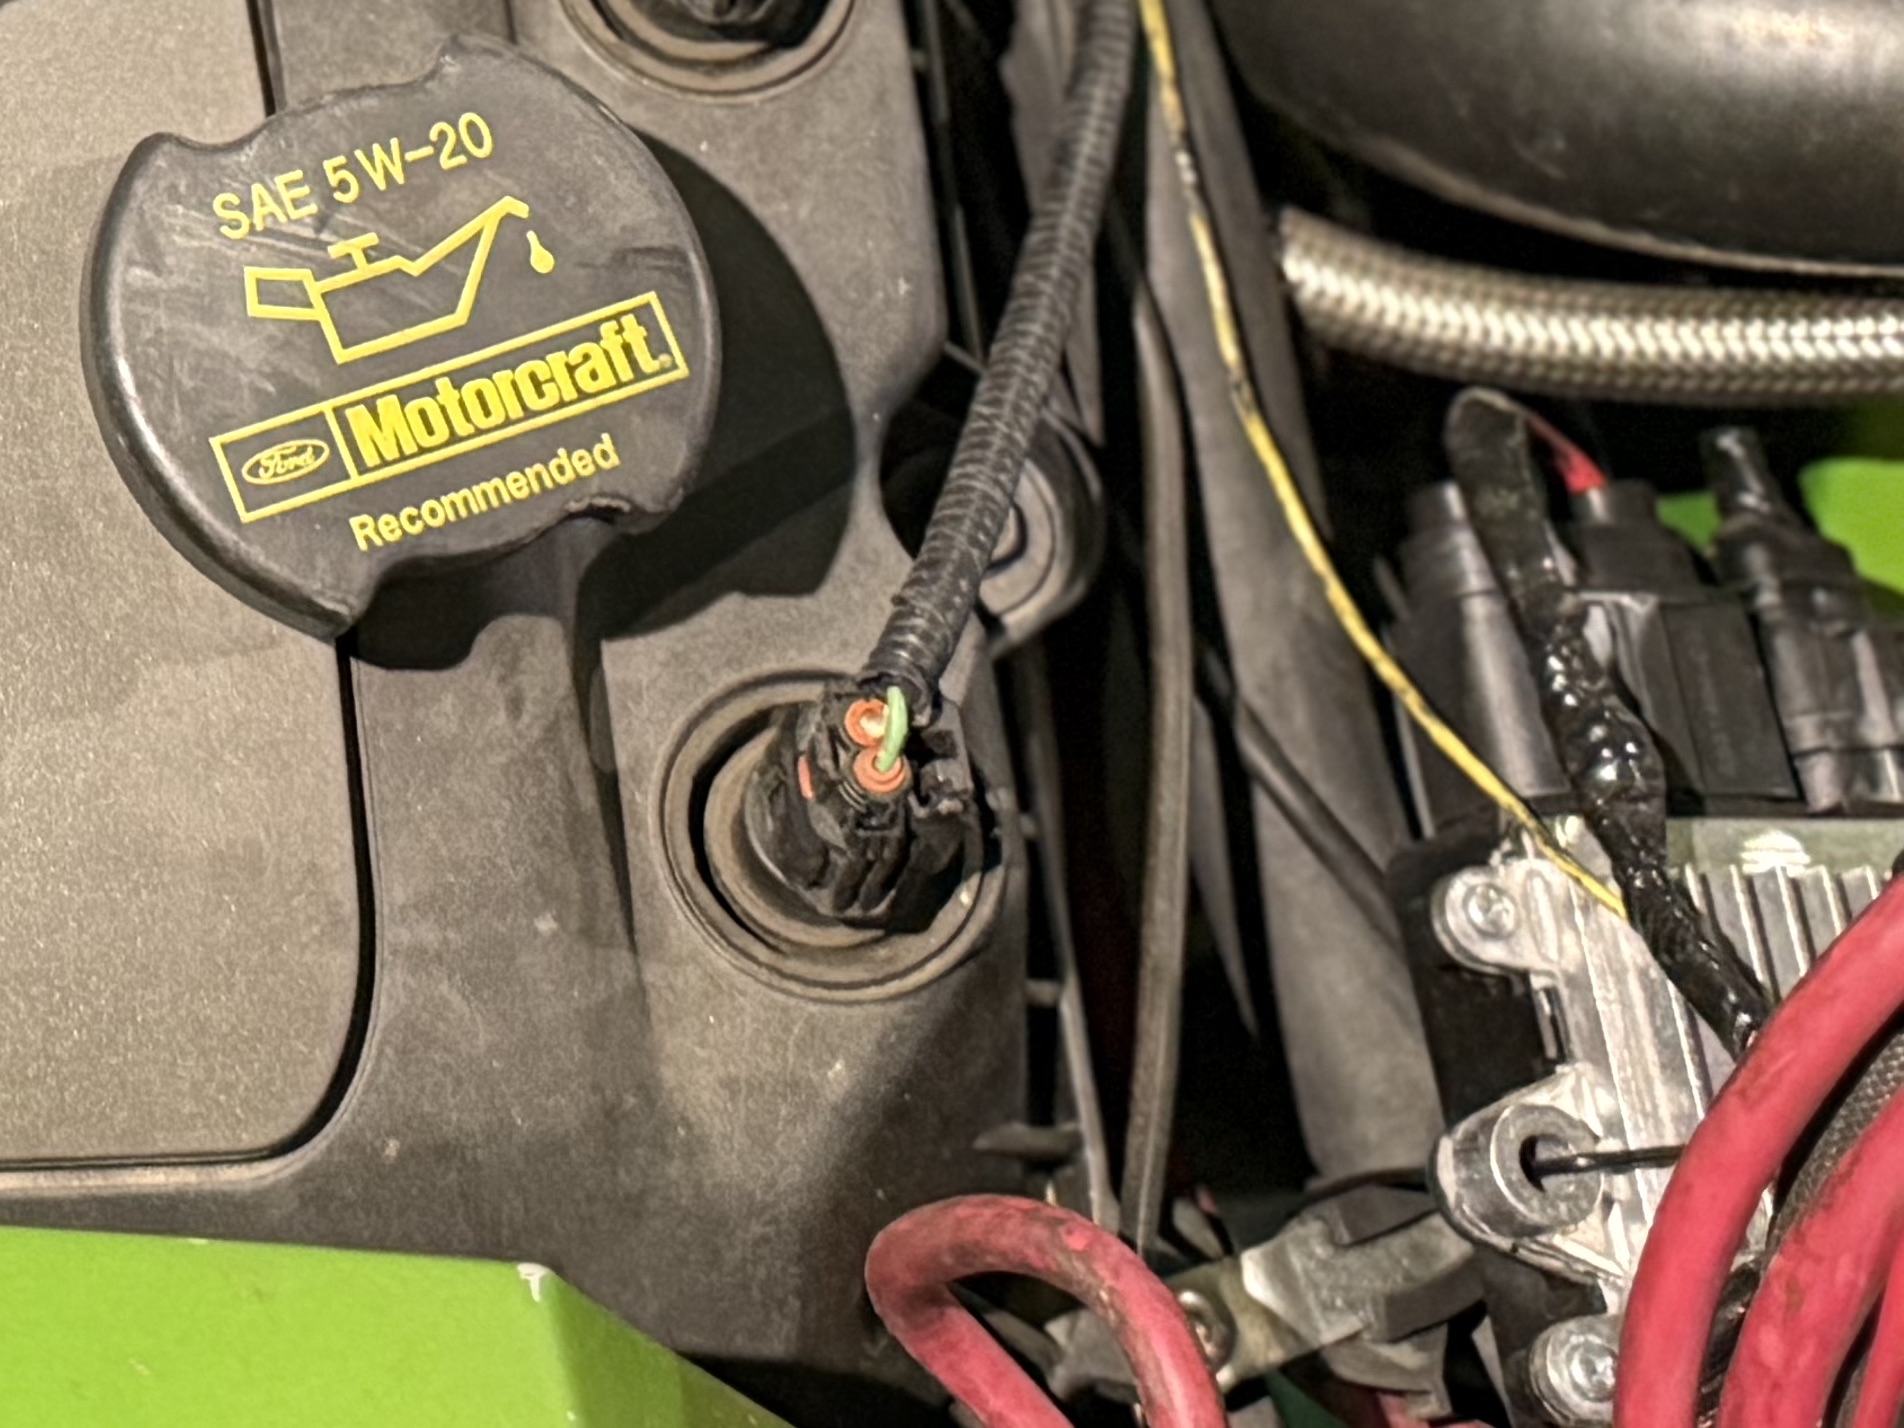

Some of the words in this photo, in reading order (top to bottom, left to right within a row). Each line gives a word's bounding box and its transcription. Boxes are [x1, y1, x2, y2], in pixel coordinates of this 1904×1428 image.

[211, 169, 317, 240] SAE
[323, 111, 493, 204] 5W-20
[349, 432, 621, 552] Recommended
